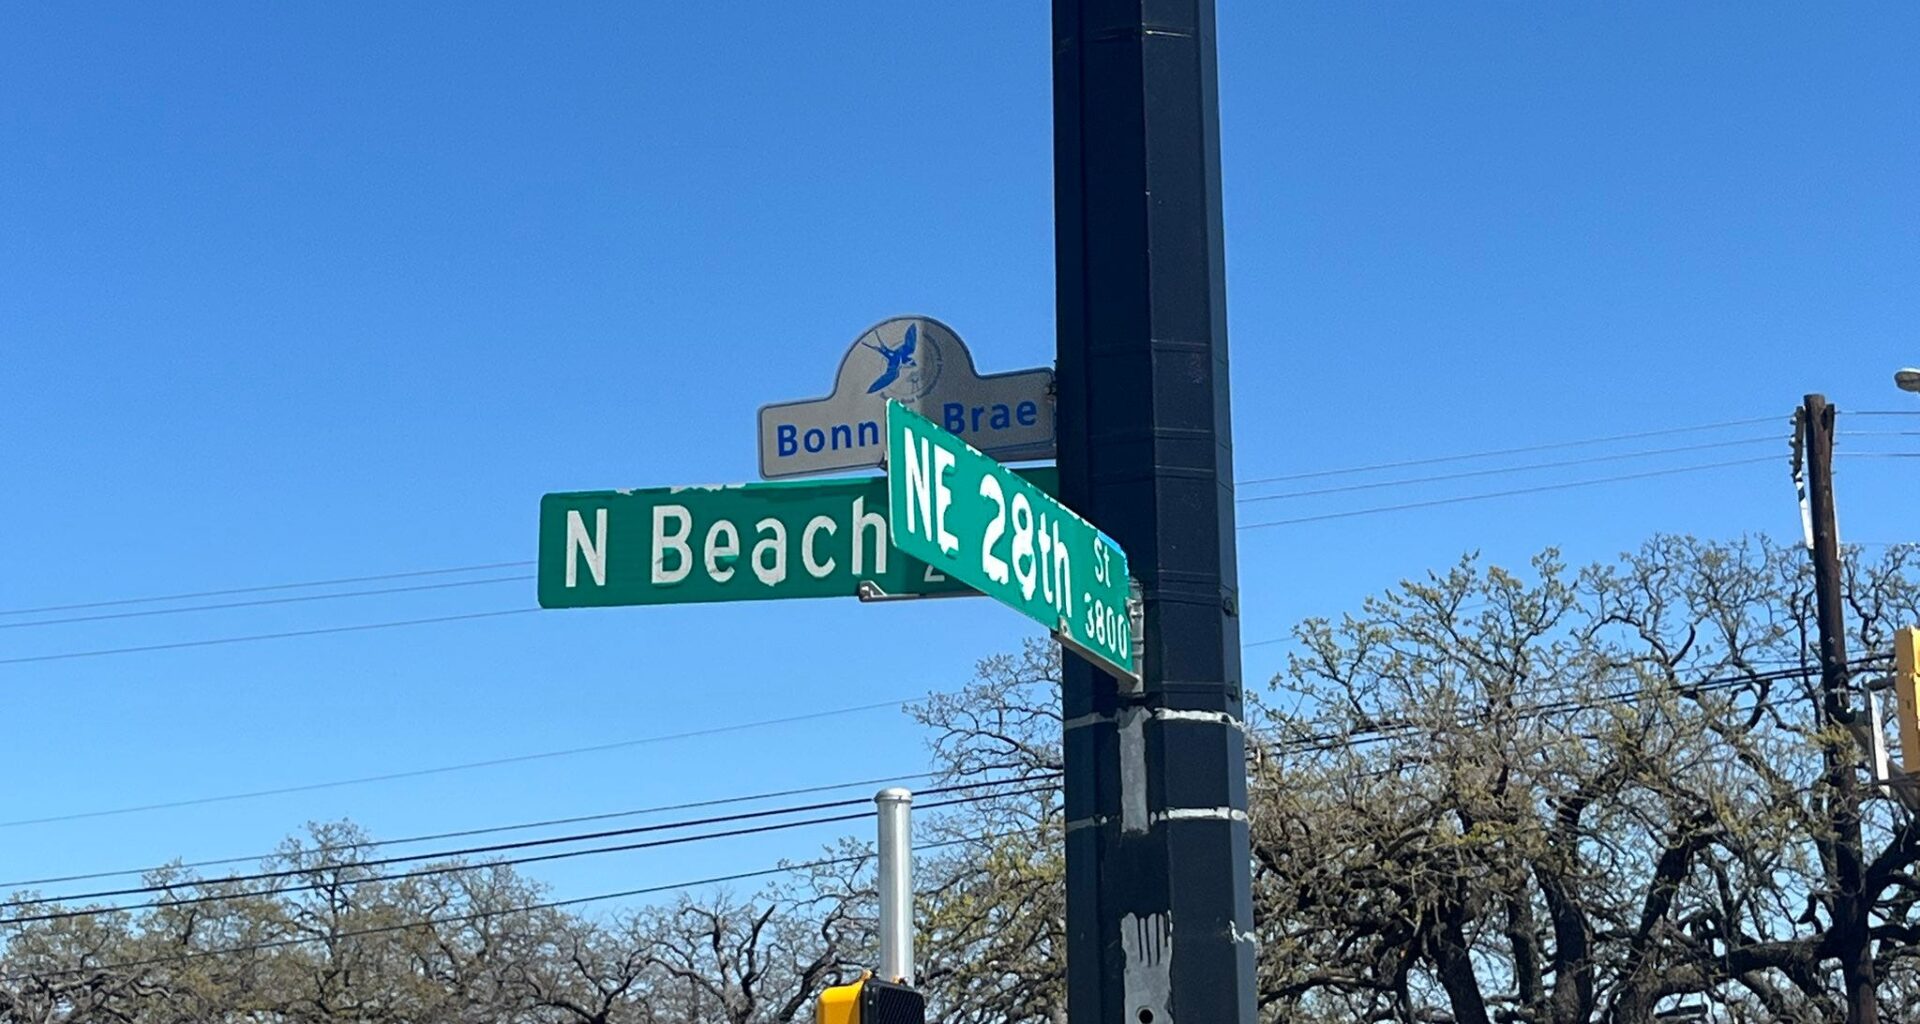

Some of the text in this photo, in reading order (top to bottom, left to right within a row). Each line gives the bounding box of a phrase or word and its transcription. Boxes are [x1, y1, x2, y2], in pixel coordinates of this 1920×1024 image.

[777, 400, 1037, 457] Bonn Brae
[565, 496, 887, 588] N Beach
[904, 427, 1072, 619] NE 28th
[1093, 537, 1111, 588] St
[1084, 592, 1127, 660] 3800
